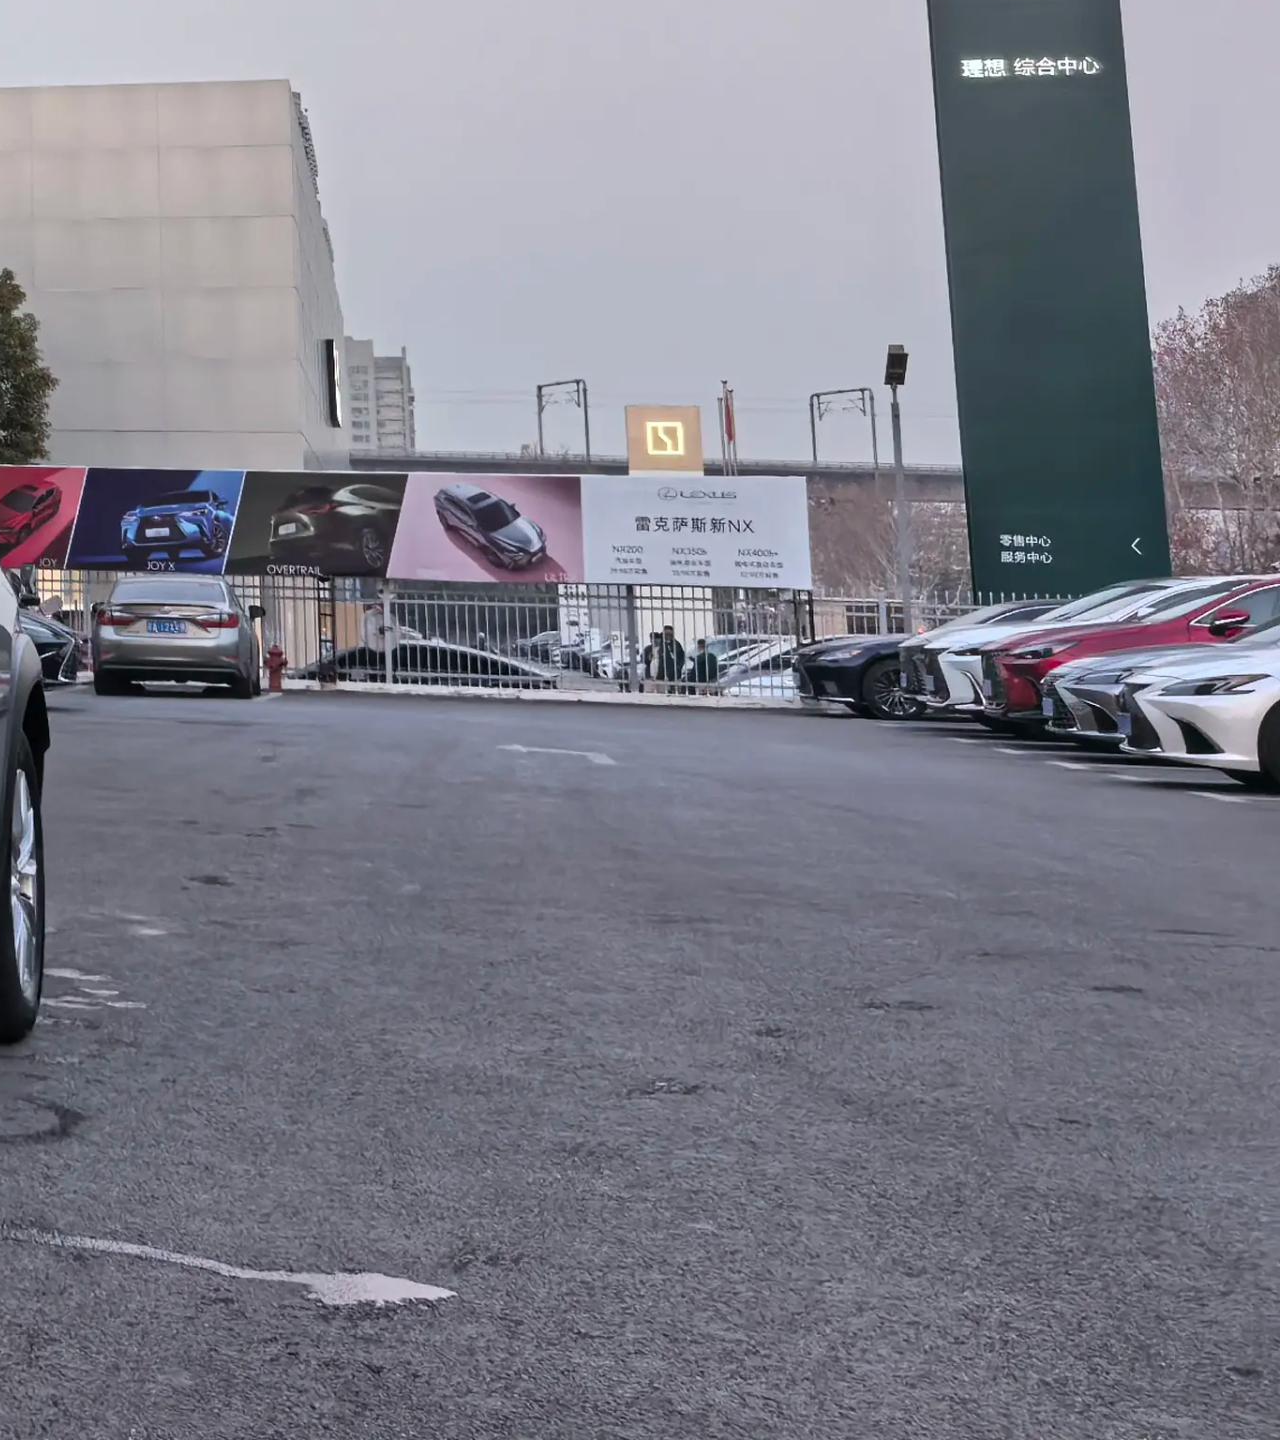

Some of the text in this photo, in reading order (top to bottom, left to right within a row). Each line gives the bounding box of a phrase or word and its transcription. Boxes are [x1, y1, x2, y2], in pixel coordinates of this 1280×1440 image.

[961, 56, 1100, 77] 理想 综合中心
[680, 490, 738, 499] LEXUS
[635, 516, 755, 534] 雷克萨斯新NX
[1000, 534, 1051, 547] 零售中心
[1001, 551, 1053, 564] 服务中心
[147, 561, 166, 571] JOY
[266, 564, 322, 576] OVERTRAIL
